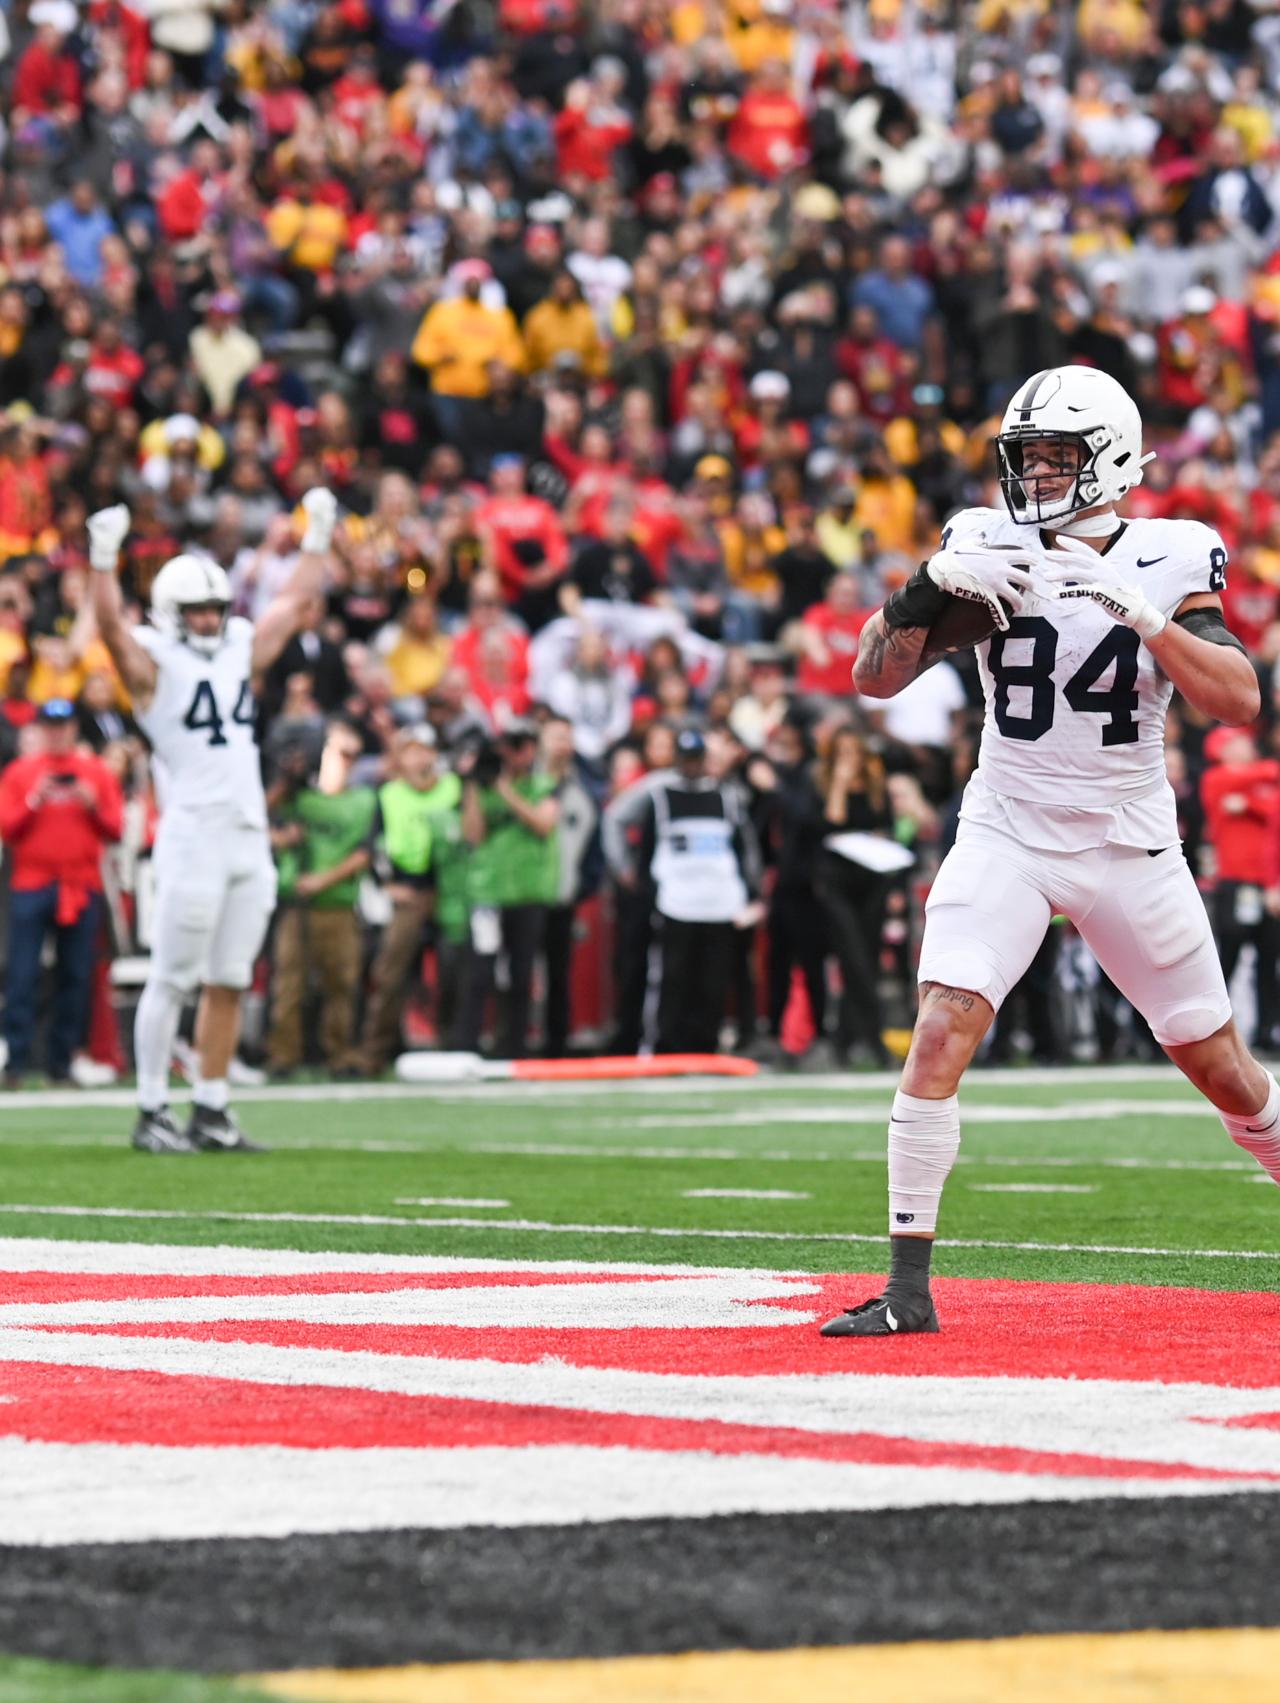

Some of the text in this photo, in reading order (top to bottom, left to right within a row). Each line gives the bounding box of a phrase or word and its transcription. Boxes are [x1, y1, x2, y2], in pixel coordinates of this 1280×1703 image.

[1059, 589, 1130, 618] PENN STATE
[184, 679, 257, 747] 44
[987, 616, 1142, 747] 84
